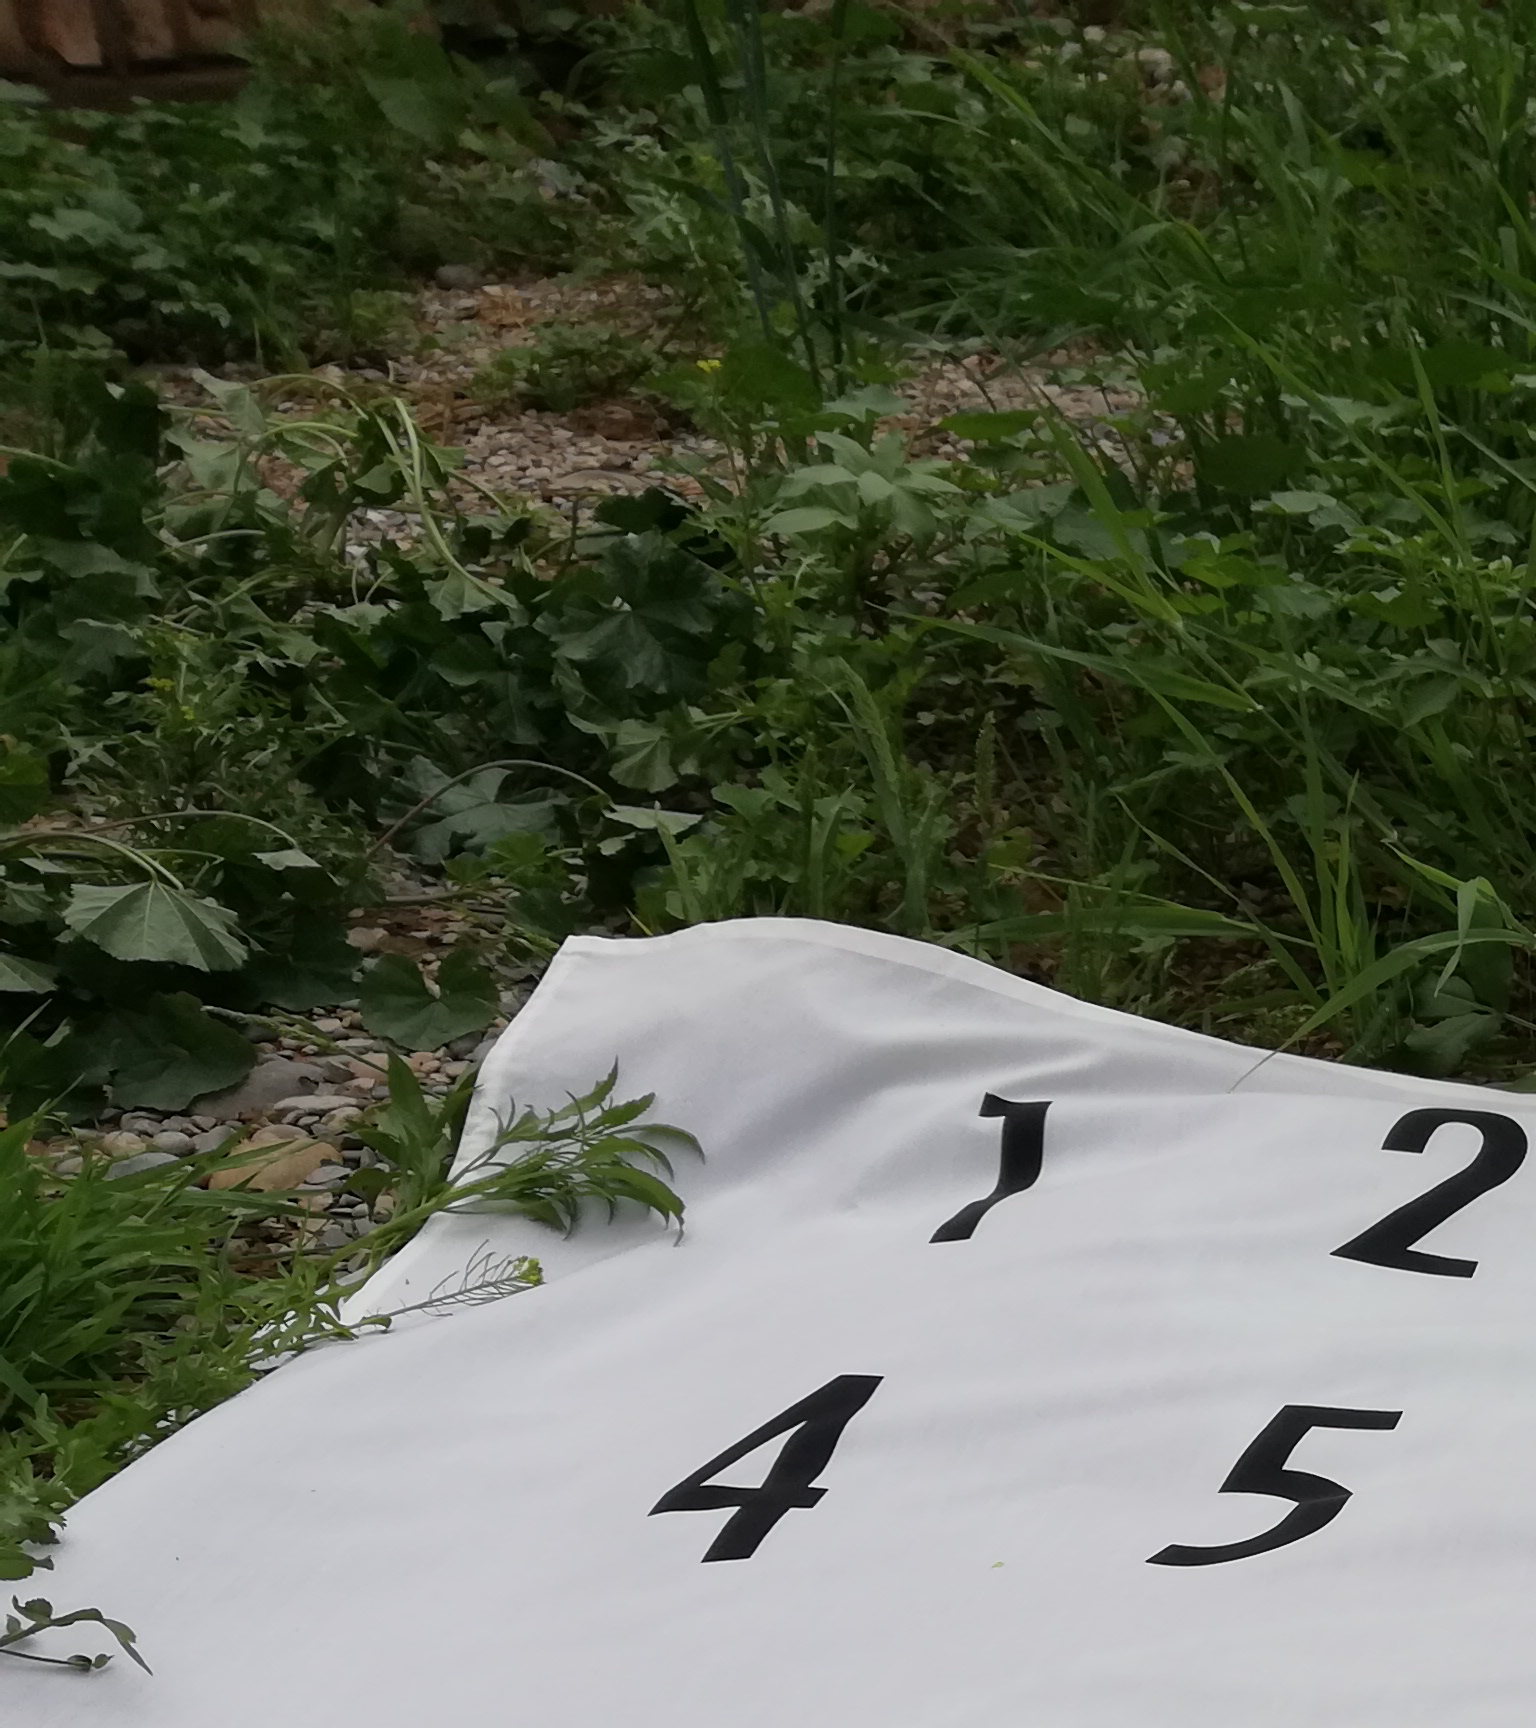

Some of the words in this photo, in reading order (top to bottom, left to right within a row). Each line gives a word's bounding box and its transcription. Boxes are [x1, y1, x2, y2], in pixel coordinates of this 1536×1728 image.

[929, 1093, 1053, 1244] 1
[1329, 1107, 1528, 1279] 2
[647, 1373, 885, 1564] 4
[1145, 1403, 1403, 1567] 5
